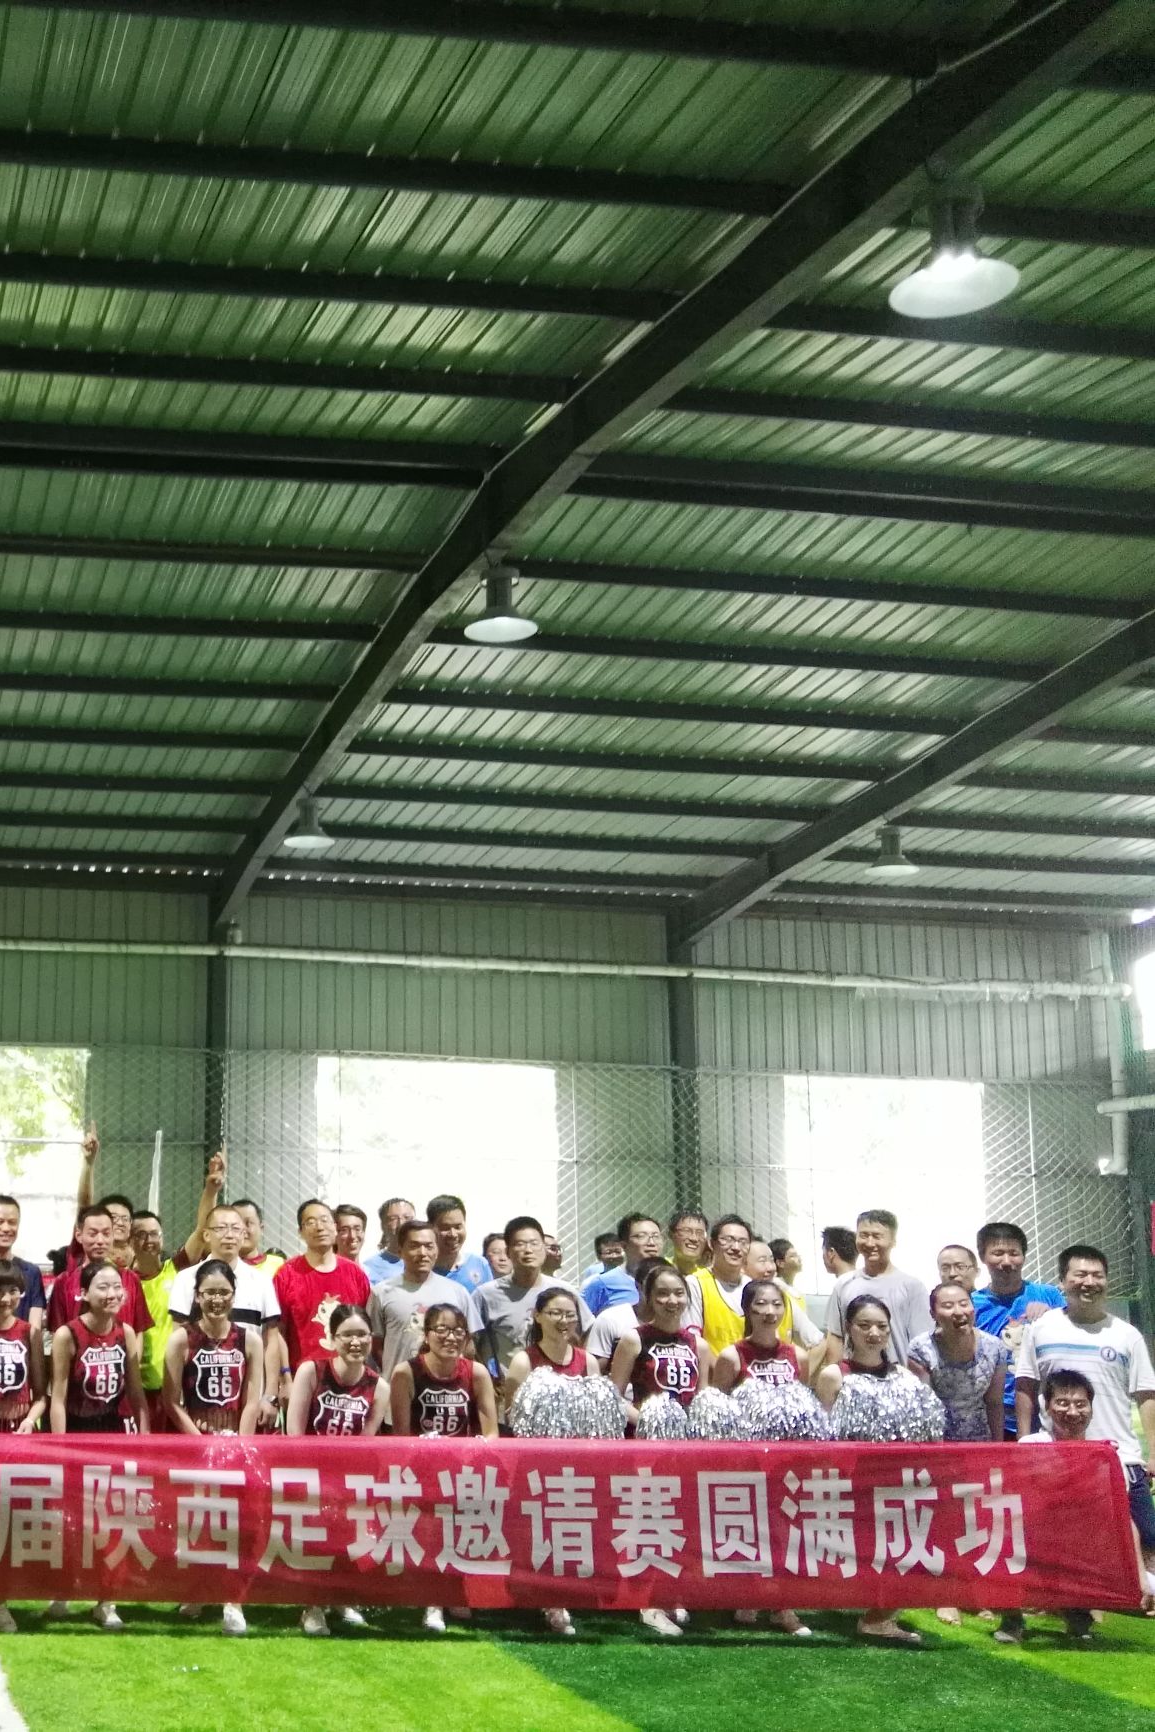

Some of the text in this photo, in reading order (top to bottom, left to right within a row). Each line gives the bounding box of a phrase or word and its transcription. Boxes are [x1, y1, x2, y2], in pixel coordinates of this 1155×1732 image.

[96, 1373, 118, 1394] 66
[667, 1365, 691, 1387] 66
[208, 1376, 232, 1397] 66
[325, 1395, 363, 1411] CALIFORNIA
[425, 1394, 464, 1403] CALIFORNIA
[326, 1419, 354, 1435] 66
[433, 1416, 459, 1432] 66
